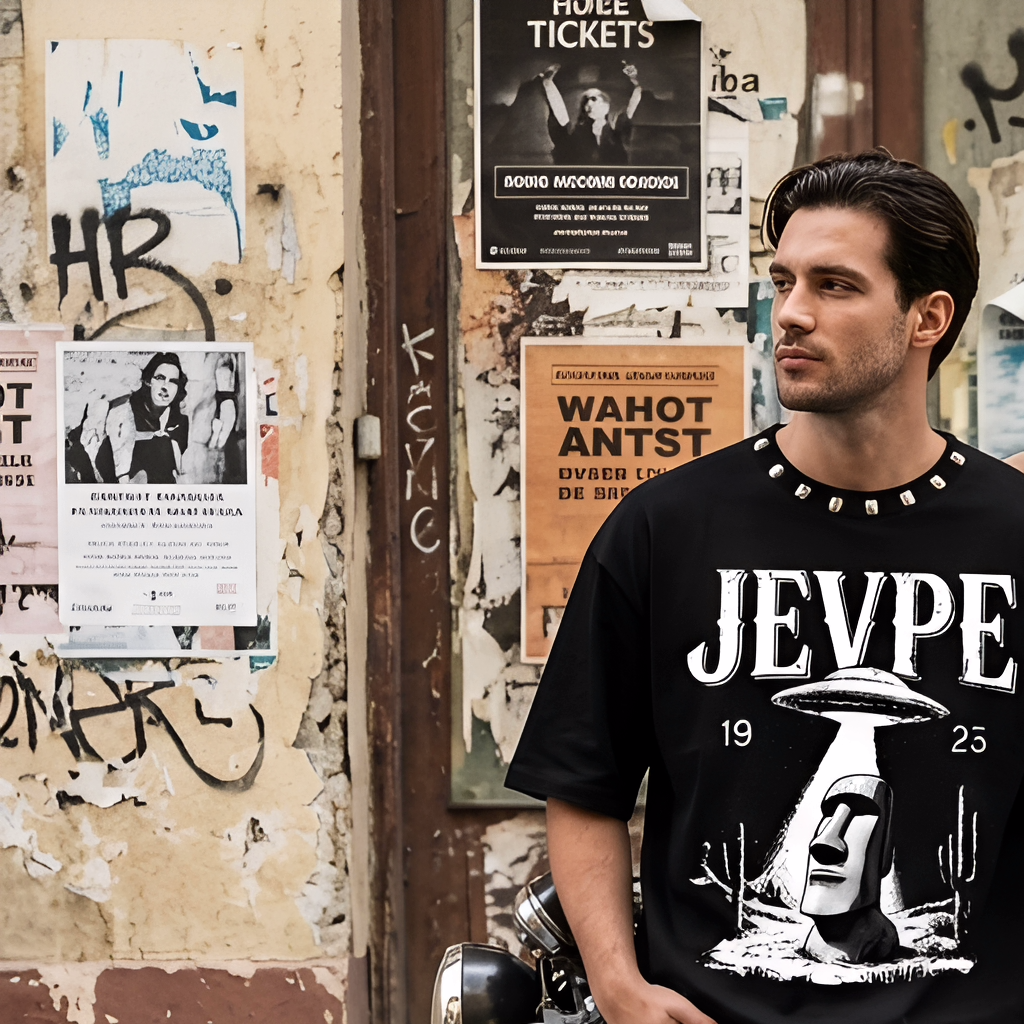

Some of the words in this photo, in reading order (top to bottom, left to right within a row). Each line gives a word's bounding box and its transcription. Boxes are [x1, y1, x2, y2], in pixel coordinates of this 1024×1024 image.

[526, 20, 655, 48] TICKETS
[557, 396, 712, 422] WAHOT
[558, 427, 712, 457] ANTST
[686, 568, 1018, 695] JEVPE
[721, 719, 753, 748] 19
